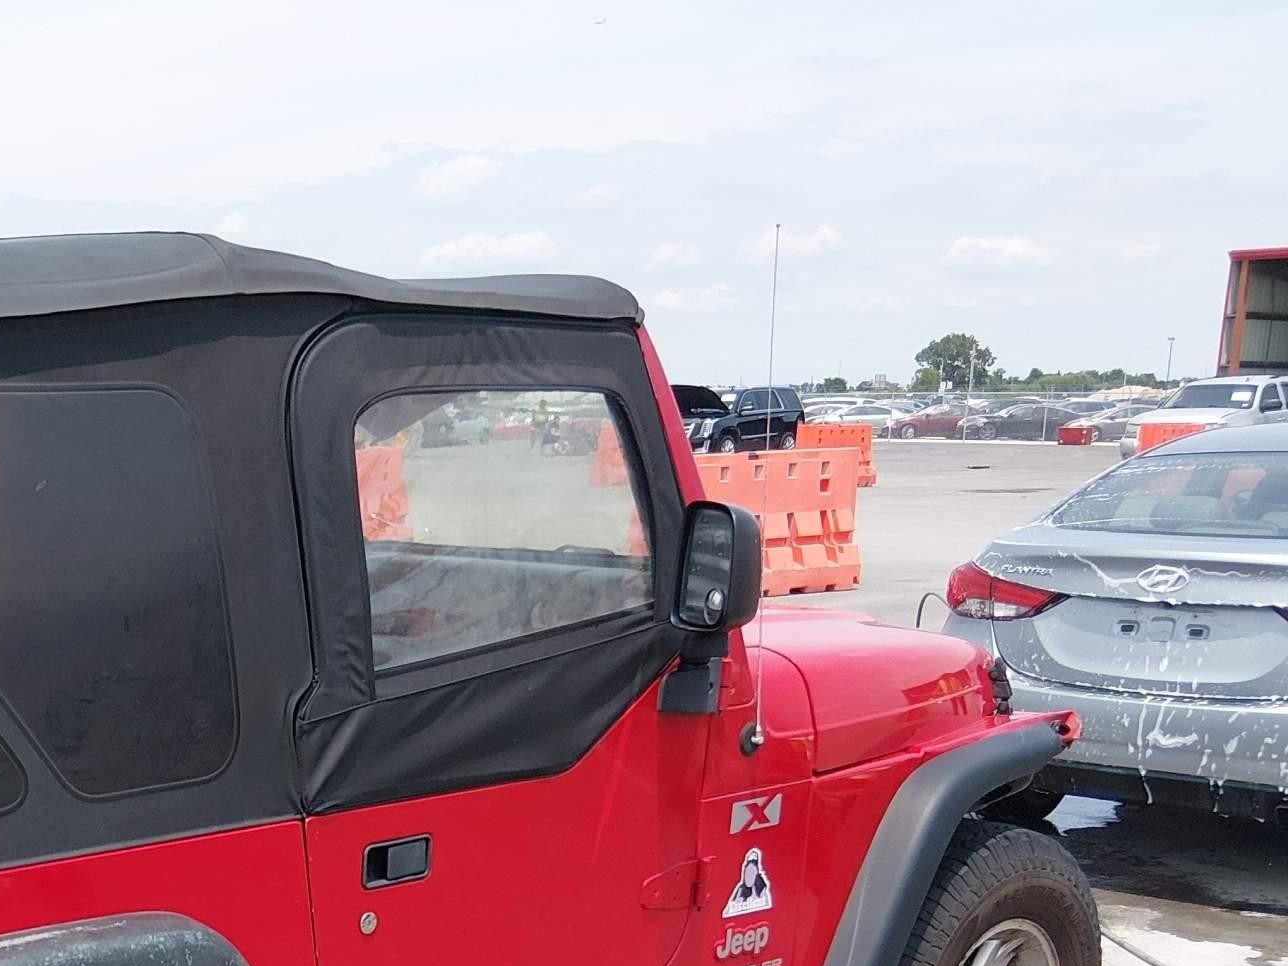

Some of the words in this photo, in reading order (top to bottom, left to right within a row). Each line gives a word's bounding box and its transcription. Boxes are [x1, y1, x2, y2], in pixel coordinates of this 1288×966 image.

[1000, 564, 1054, 576] ELANTRA
[732, 793, 782, 834] X
[715, 925, 770, 960] Jeep
